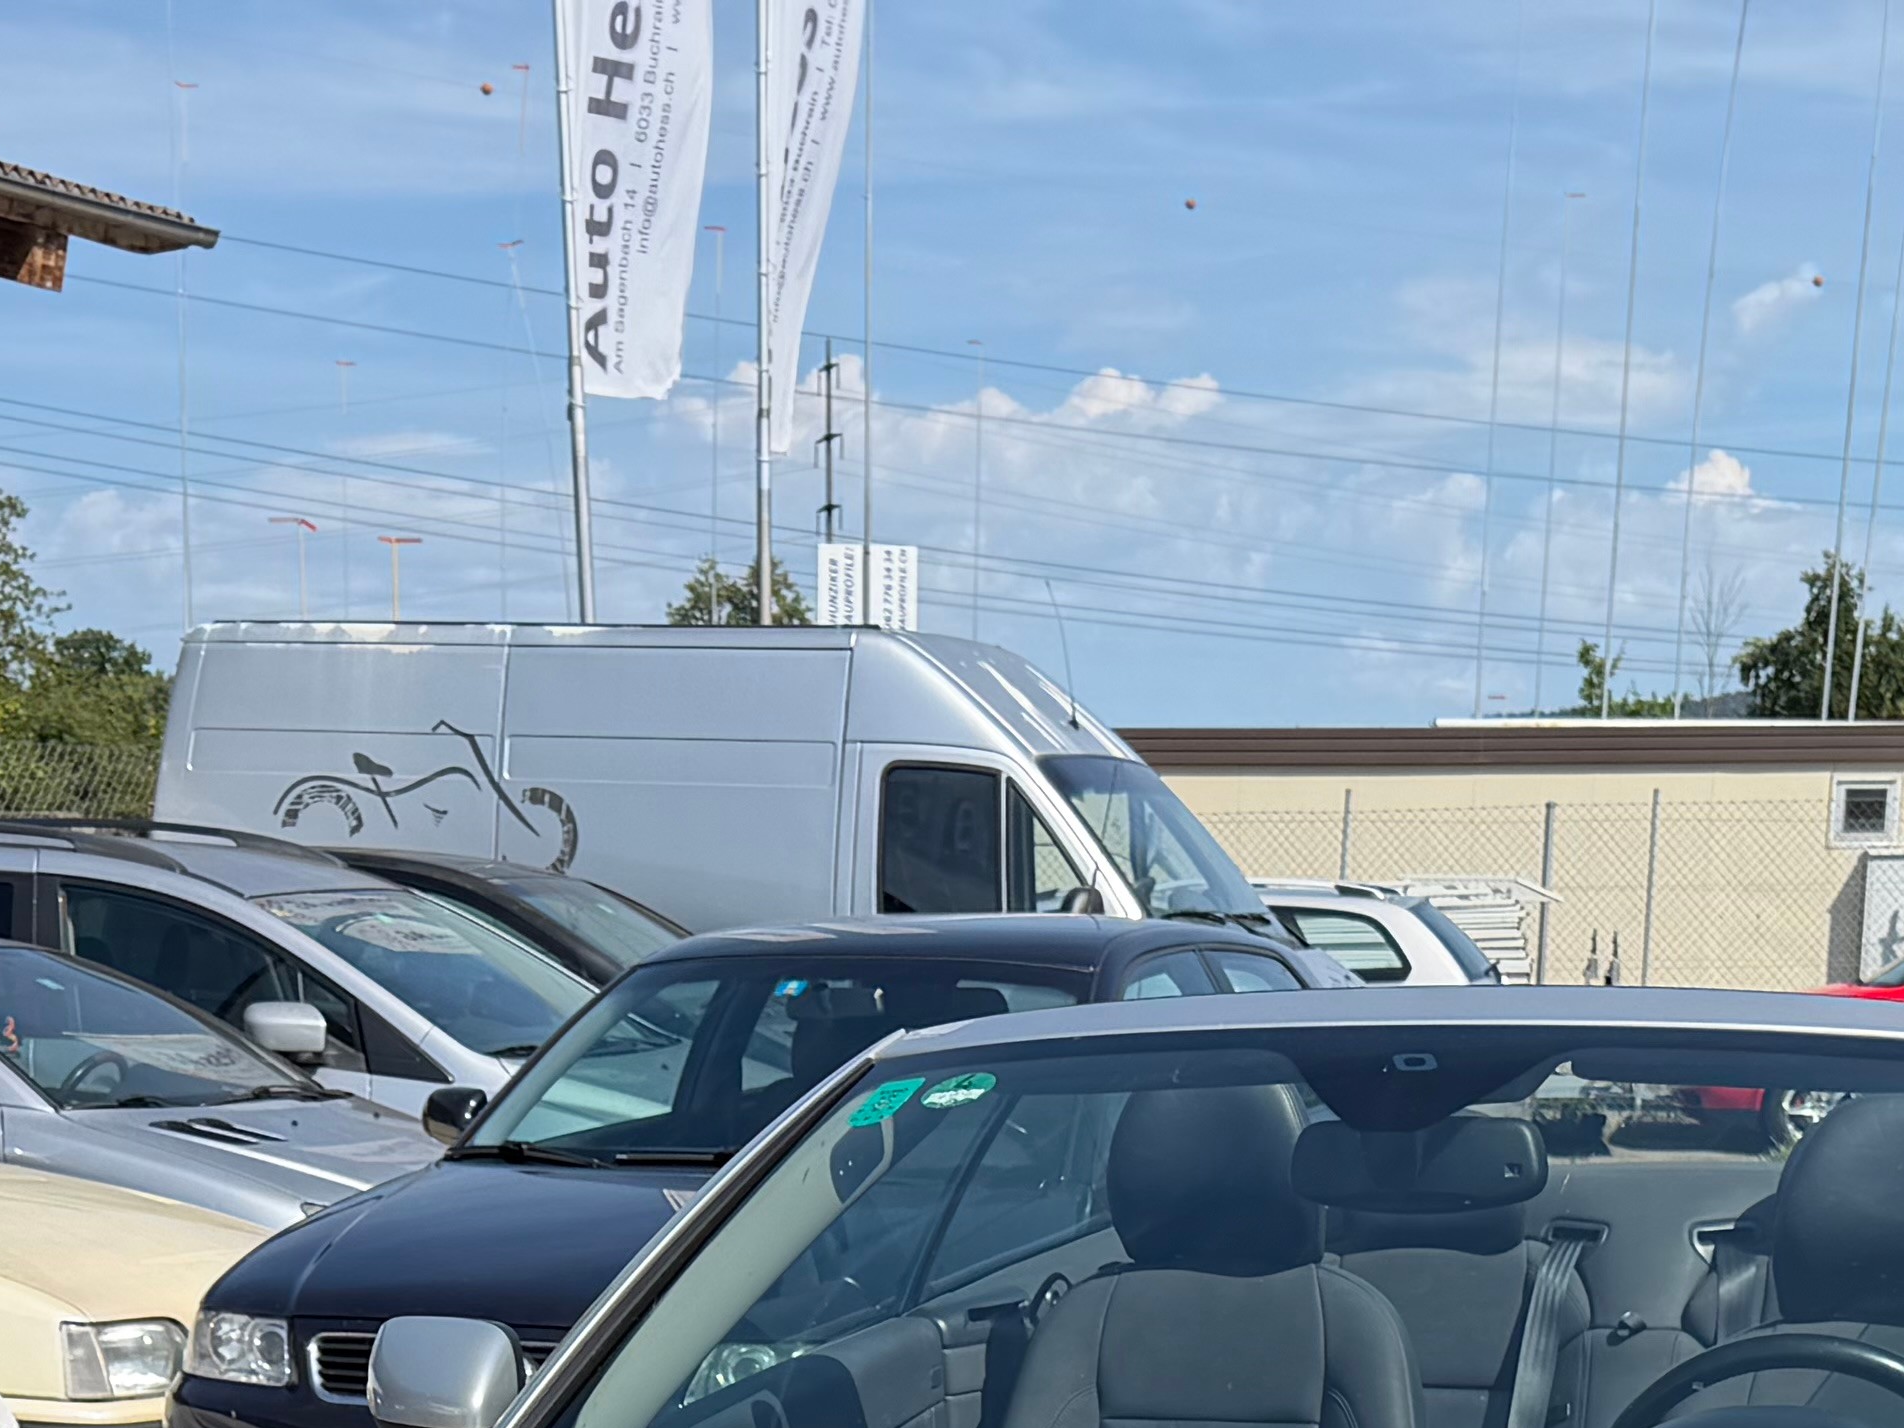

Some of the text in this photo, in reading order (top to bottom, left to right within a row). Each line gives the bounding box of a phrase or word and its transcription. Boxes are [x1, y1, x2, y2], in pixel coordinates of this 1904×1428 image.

[584, 1, 642, 374] Auto He
[613, 340, 624, 375] Am
[623, 189, 638, 210] 14
[634, 92, 654, 143] 6033
